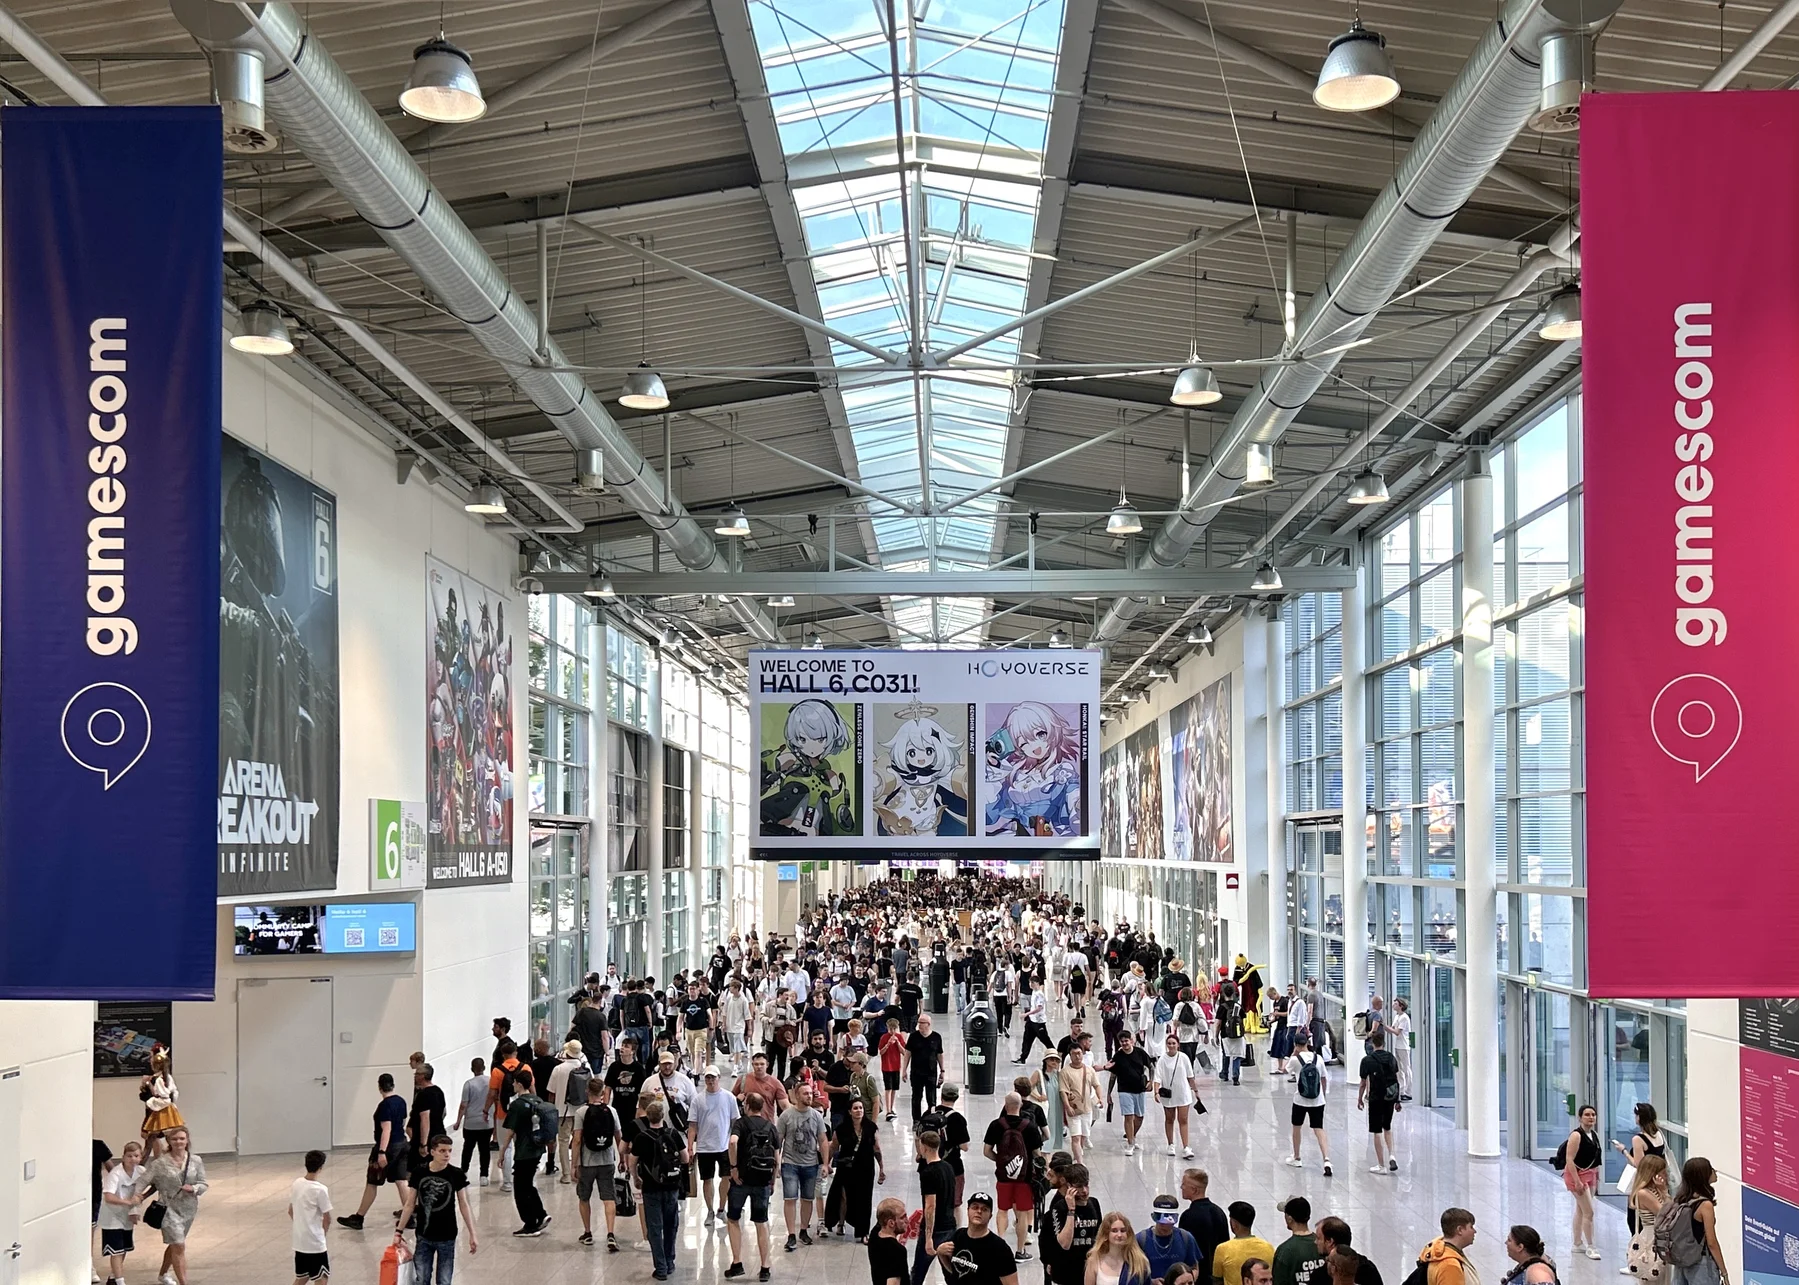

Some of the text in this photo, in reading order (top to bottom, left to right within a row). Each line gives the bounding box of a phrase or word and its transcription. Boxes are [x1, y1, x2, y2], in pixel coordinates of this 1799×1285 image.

[1674, 303, 1728, 647] gamescom
[86, 317, 138, 655] gamescom
[315, 518, 329, 589] 6
[760, 660, 875, 673] WELCOME TO
[968, 660, 1089, 677] HOYOVERSE
[760, 674, 823, 693] HALL
[222, 756, 287, 798] ARENA
[385, 821, 399, 879] 6
[221, 852, 289, 873] INFINITE
[459, 852, 479, 877] HALL
[480, 852, 485, 876] 6
[254, 922, 290, 931] OMMUNITY
[1005, 1155, 1020, 1175] NIKE
[1075, 1219, 1098, 1228] PERDRY
[1302, 1259, 1325, 1270] COLD
[1295, 1270, 1313, 1282] HE
